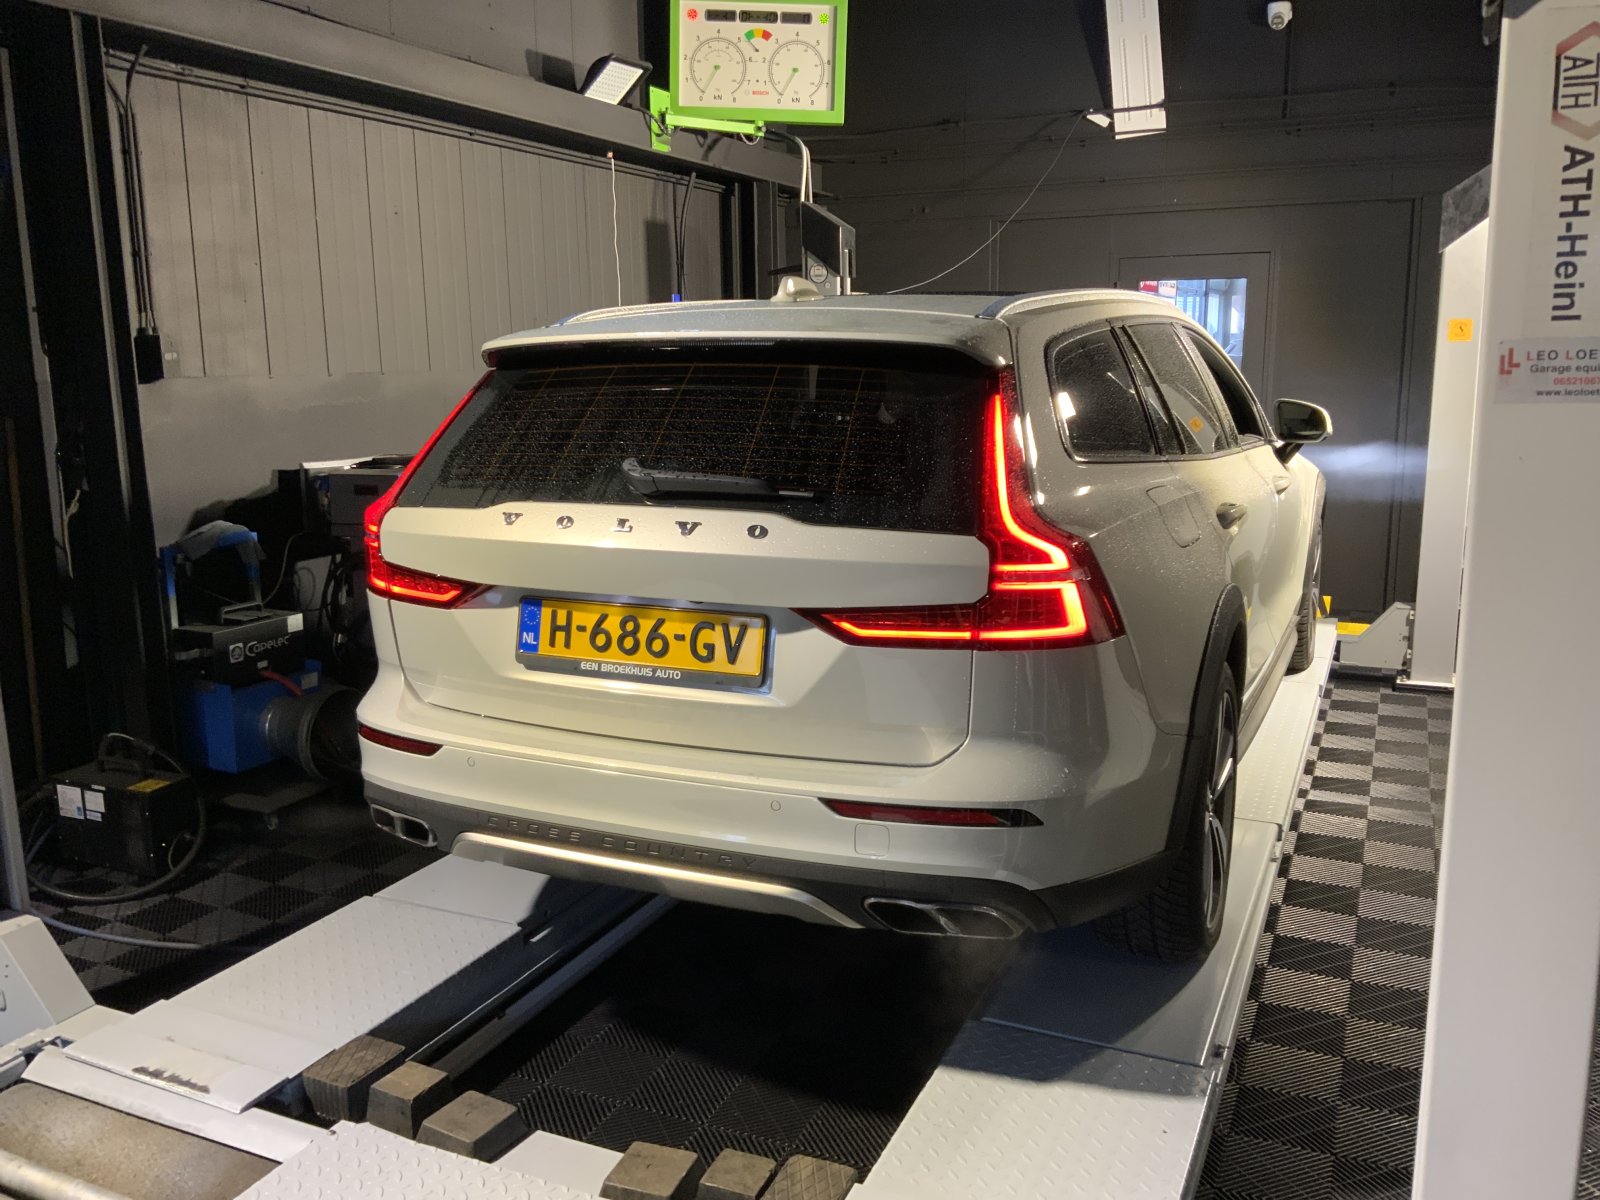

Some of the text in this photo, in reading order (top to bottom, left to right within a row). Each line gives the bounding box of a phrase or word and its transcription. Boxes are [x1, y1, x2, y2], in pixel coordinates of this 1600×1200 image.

[1551, 145, 1595, 322] ATH-Heinl
[1526, 349, 1559, 361] LEO
[1530, 363, 1572, 375] Garage
[502, 511, 769, 540] VOLVO
[522, 632, 538, 645] NL
[548, 608, 748, 665] H-686-GV
[580, 661, 682, 680] EEN BROEKHUIS AUTO
[487, 815, 757, 870] CROSS COUNTRY
